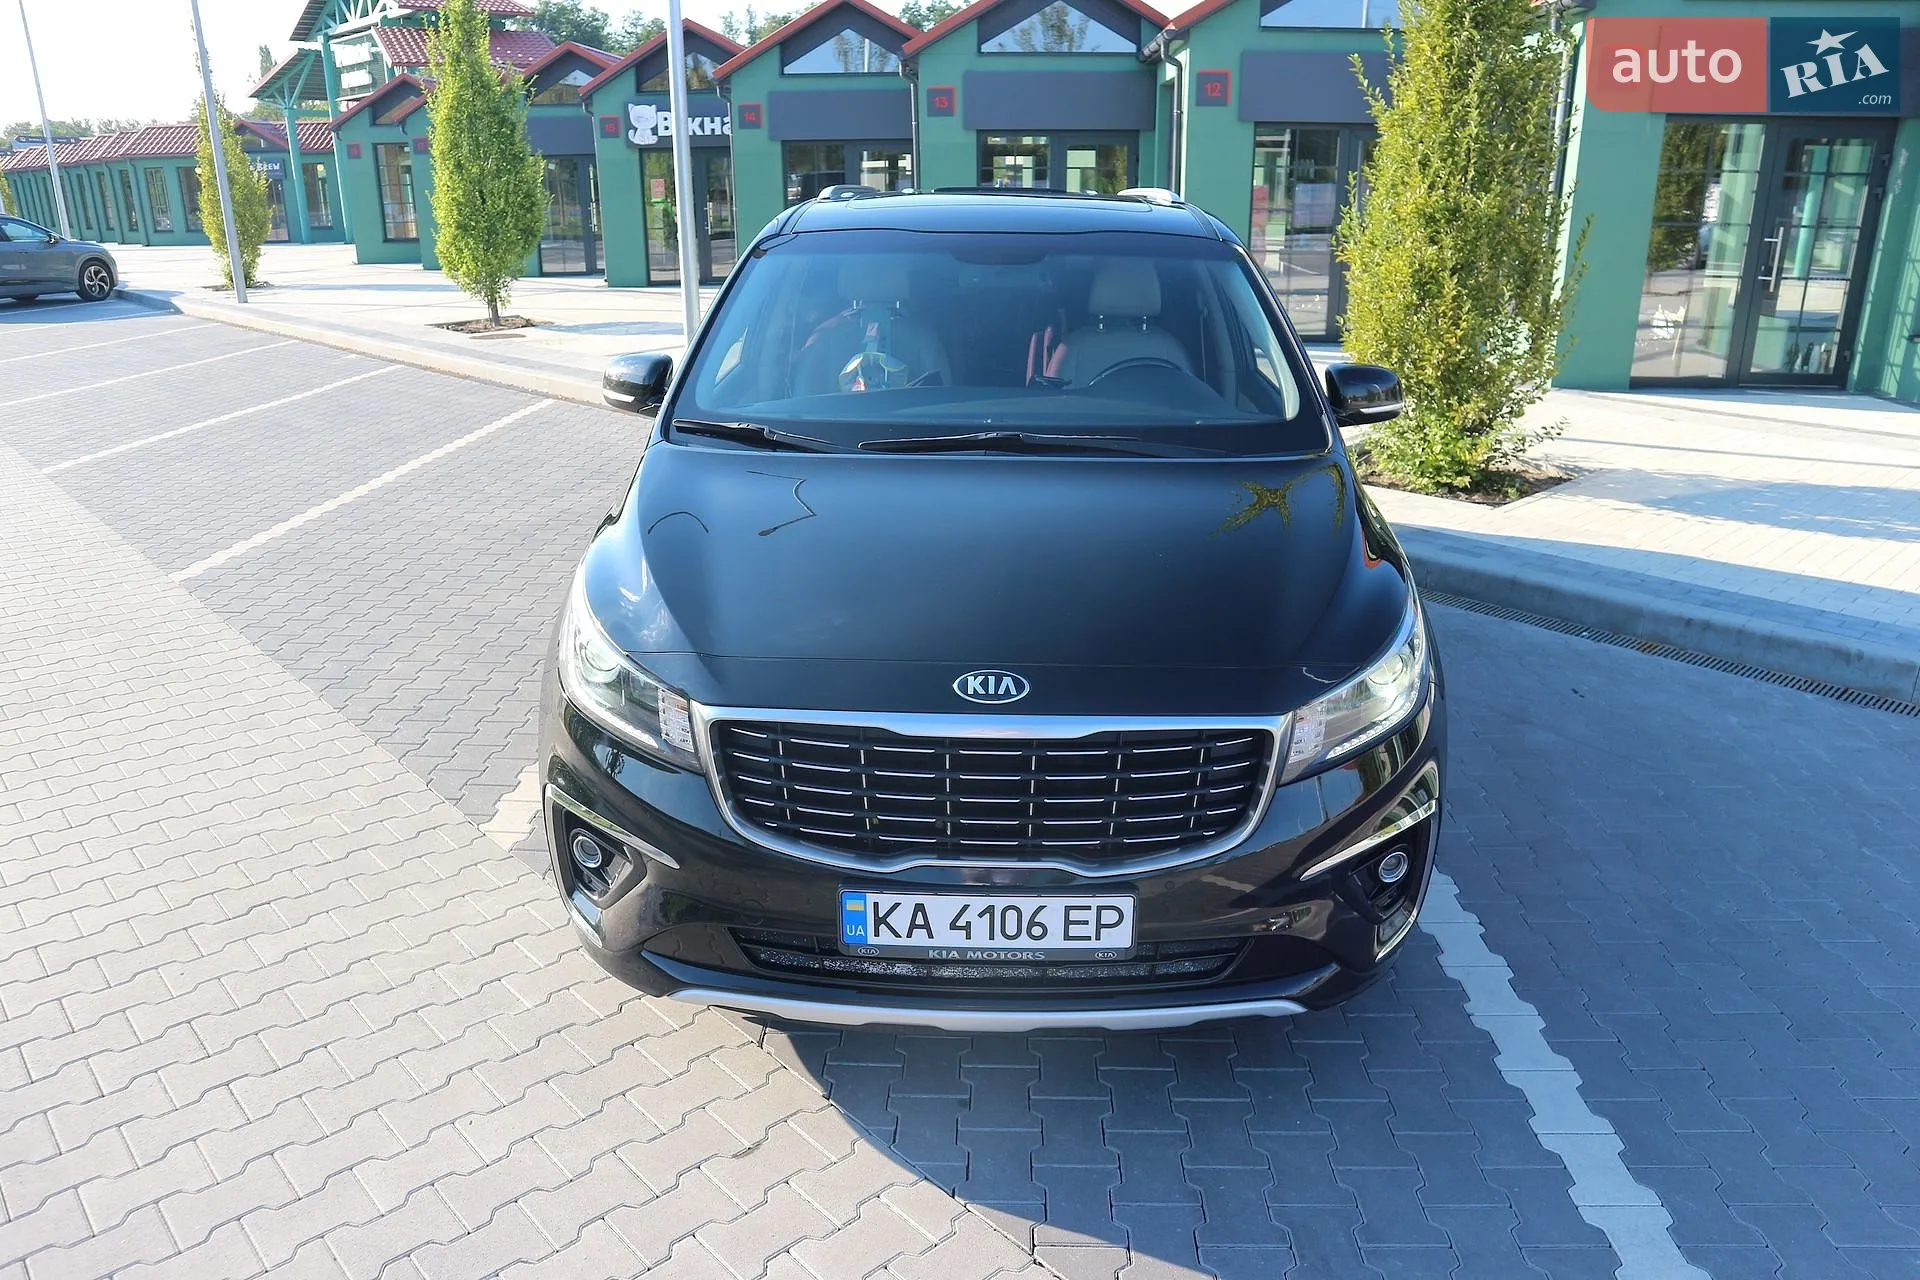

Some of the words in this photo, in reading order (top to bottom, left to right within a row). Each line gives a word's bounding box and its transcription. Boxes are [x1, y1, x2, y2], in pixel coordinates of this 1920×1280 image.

[1205, 82, 1221, 97] 12
[933, 96, 949, 109] 13
[656, 111, 732, 137] Вкна
[966, 675, 1018, 696] KIA
[873, 901, 934, 939] KA
[949, 903, 1049, 941] 4106
[1063, 905, 1125, 942] EP
[846, 924, 865, 937] UA
[928, 949, 960, 960] KIA
[966, 950, 1046, 961] MOTORS
[1098, 950, 1114, 959] KIA
